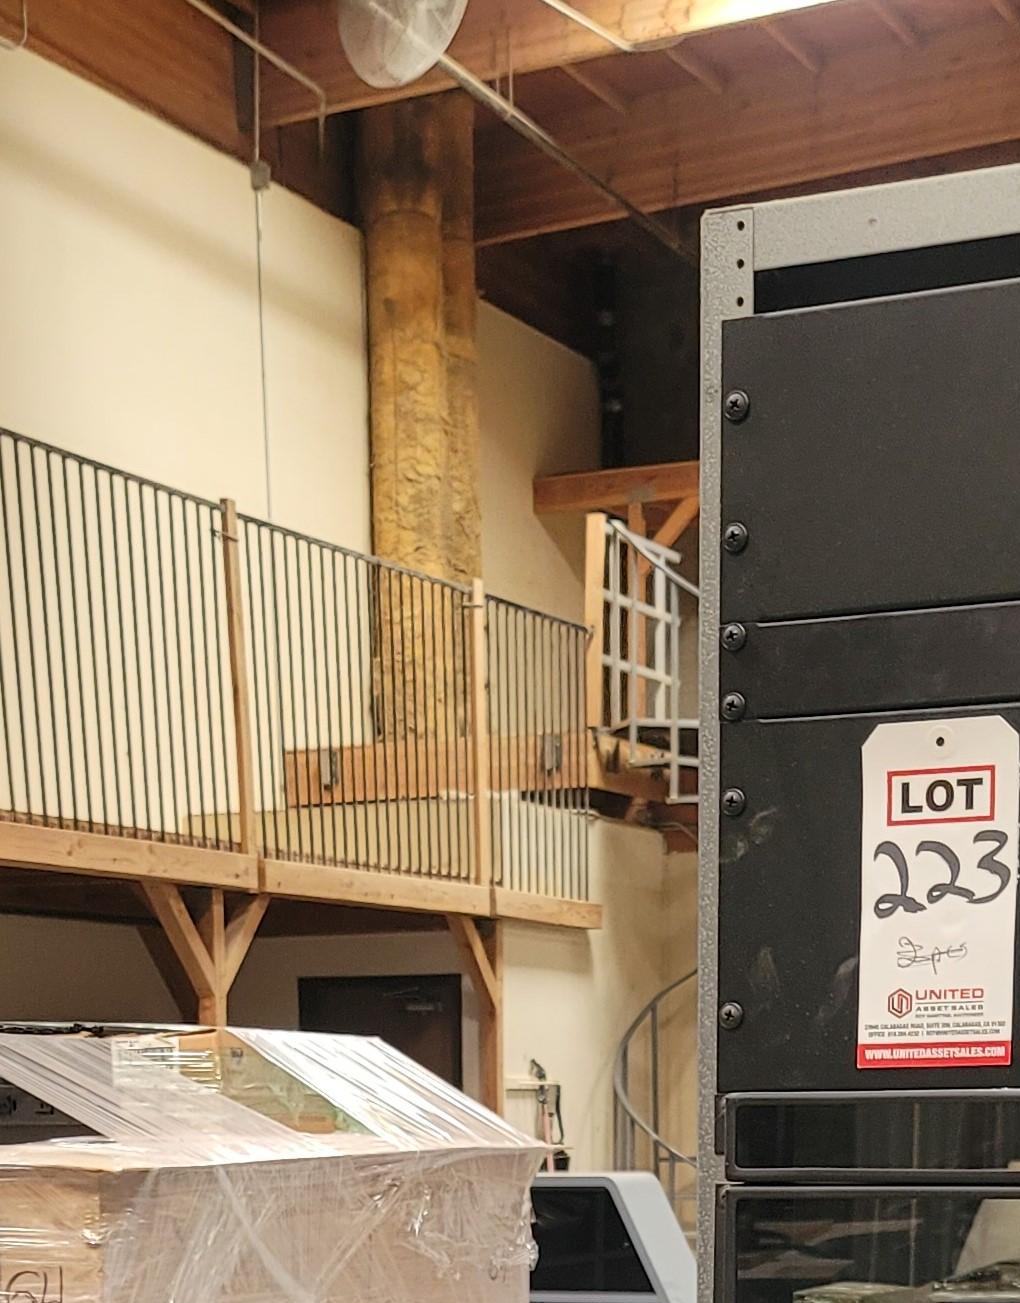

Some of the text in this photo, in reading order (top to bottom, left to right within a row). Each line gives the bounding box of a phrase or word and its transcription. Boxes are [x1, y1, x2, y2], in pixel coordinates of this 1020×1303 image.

[900, 777, 984, 814] LOT
[873, 830, 1012, 919] 223
[915, 988, 985, 1001] UNITED
[864, 1046, 1006, 1060] WWW.UNITEDASSETSALES.COM
